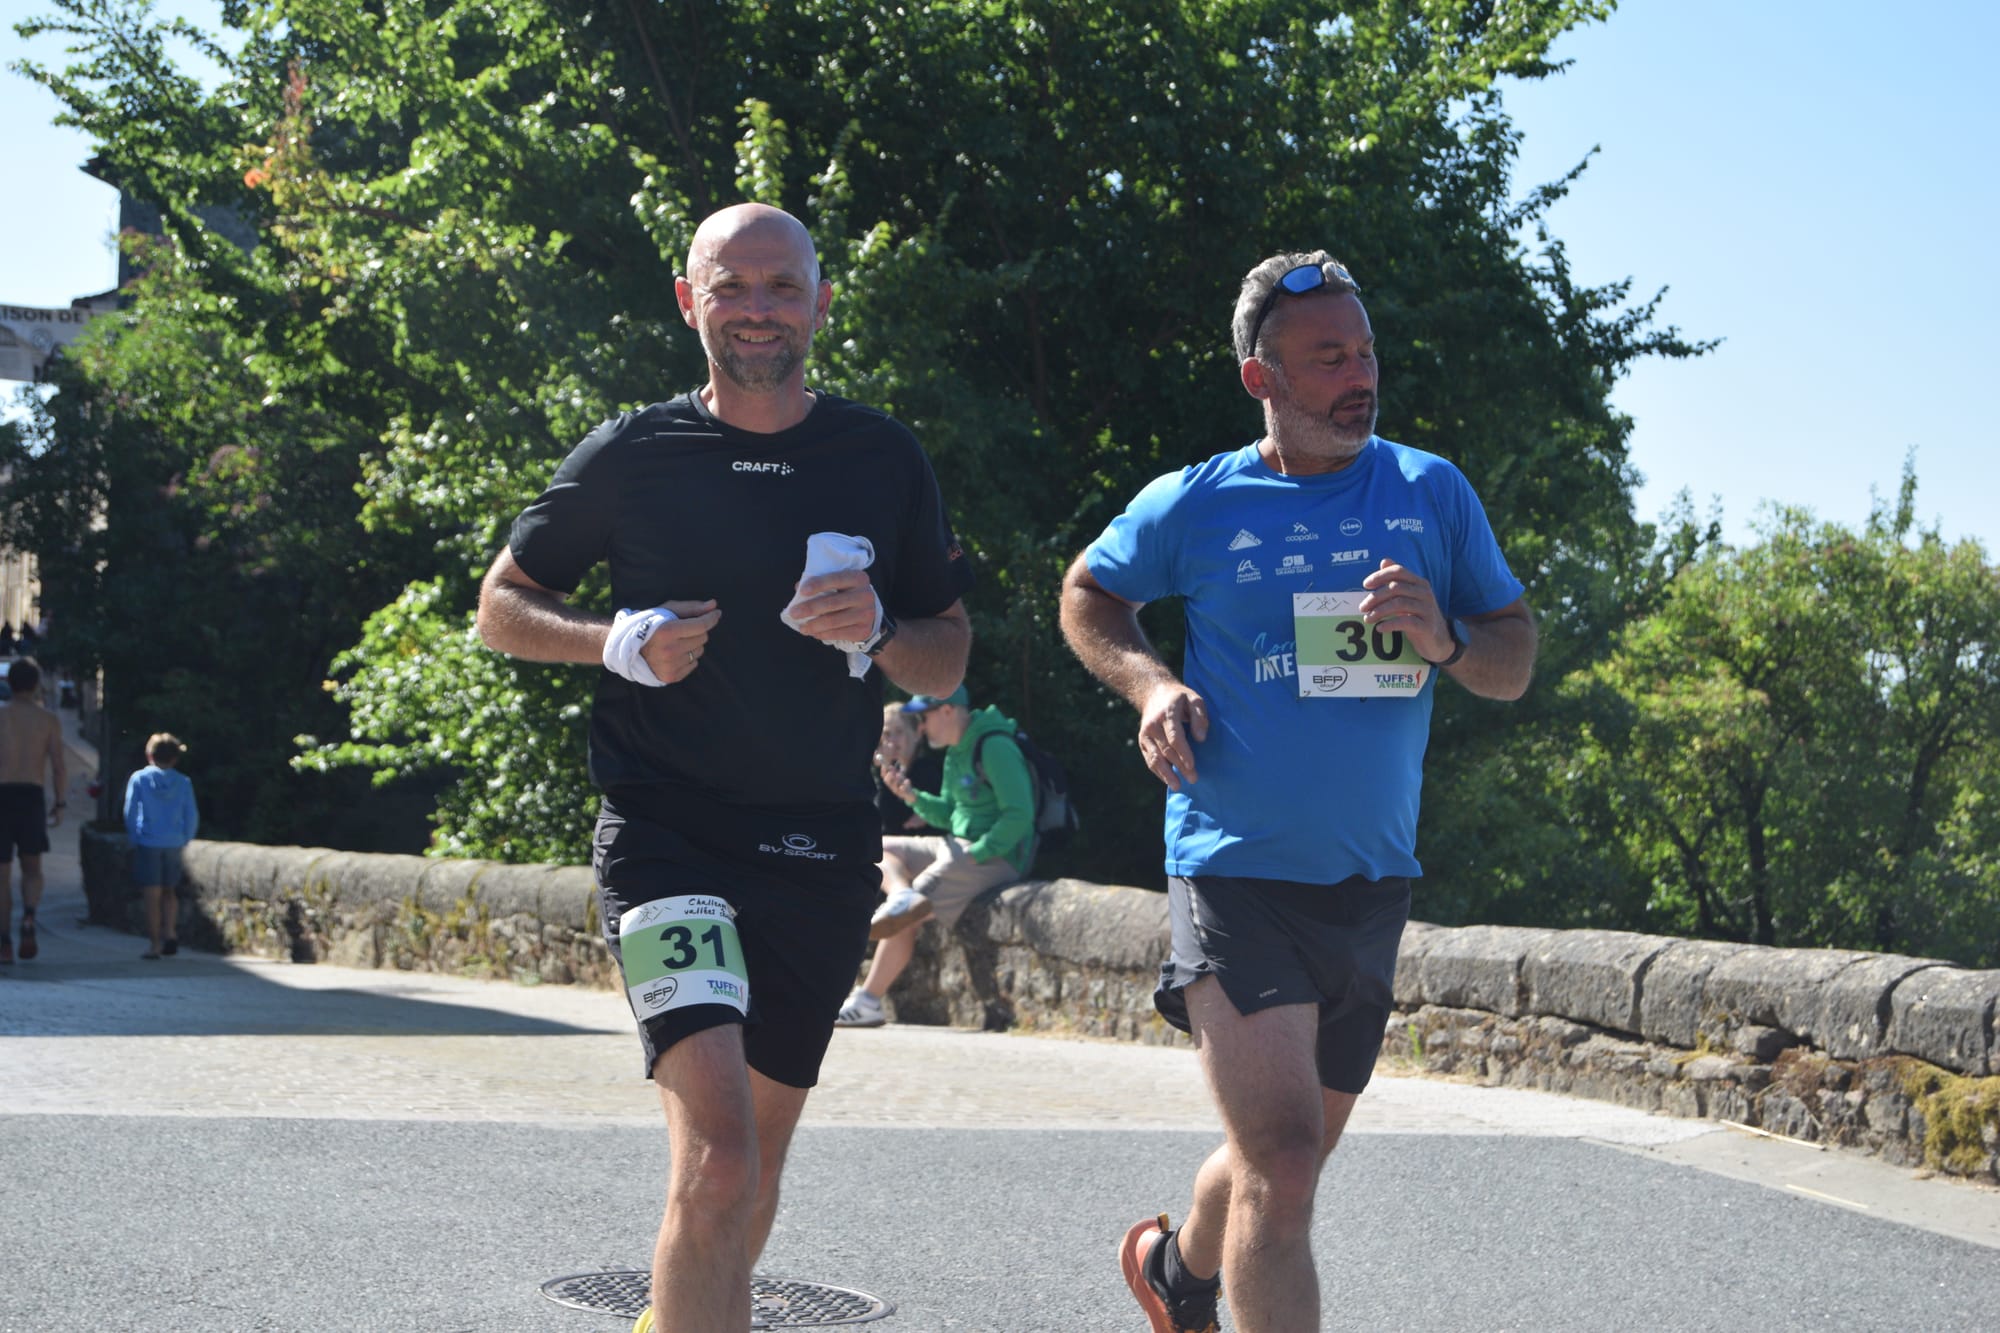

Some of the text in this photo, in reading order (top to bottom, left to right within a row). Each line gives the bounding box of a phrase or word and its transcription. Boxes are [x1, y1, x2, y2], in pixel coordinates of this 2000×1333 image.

[0, 306, 52, 322] ISON
[731, 461, 781, 473] CRAFT
[1399, 518, 1423, 527] INTER
[1401, 523, 1425, 534] SPORT
[1335, 620, 1403, 662] 30
[1255, 652, 1297, 683] INTE
[1312, 675, 1344, 684] BFP
[1374, 674, 1413, 683] TUFF'S
[758, 844, 837, 861] BV SPORT
[659, 924, 726, 970] 31
[643, 986, 673, 1004] BFP
